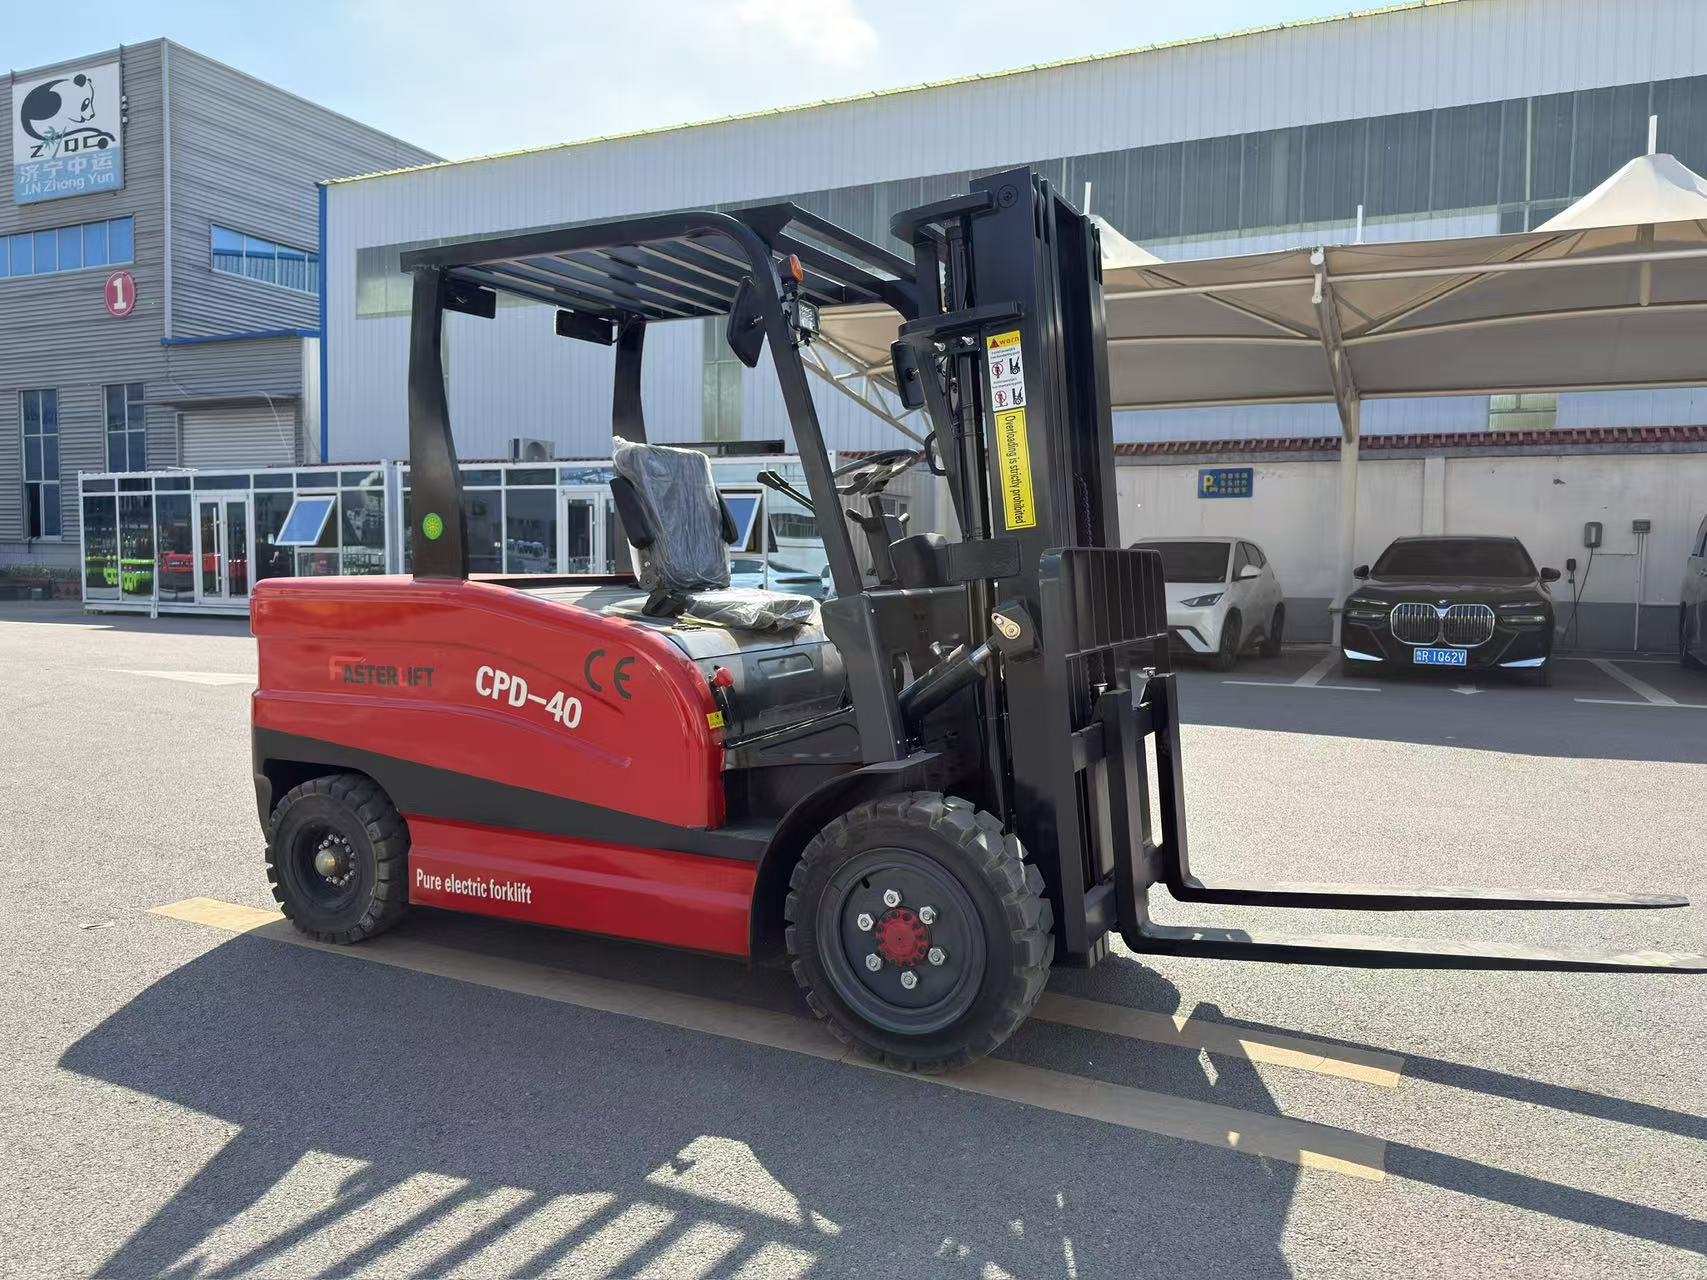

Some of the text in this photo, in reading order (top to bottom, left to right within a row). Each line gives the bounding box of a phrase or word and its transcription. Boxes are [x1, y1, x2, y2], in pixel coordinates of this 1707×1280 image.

[20, 151, 113, 184] 济宁中运
[44, 177, 85, 192] Zhong
[88, 172, 114, 185] Yun
[113, 277, 127, 310] 1
[999, 336, 1020, 345] warn
[1005, 415, 1019, 457] Overloading
[1010, 464, 1022, 488] strictly
[1010, 489, 1026, 524] prohibited
[329, 656, 435, 688] FASTERLIFT
[584, 649, 635, 700] CE
[475, 665, 582, 729] CPD-40
[416, 868, 532, 904] Pure electric forklift
